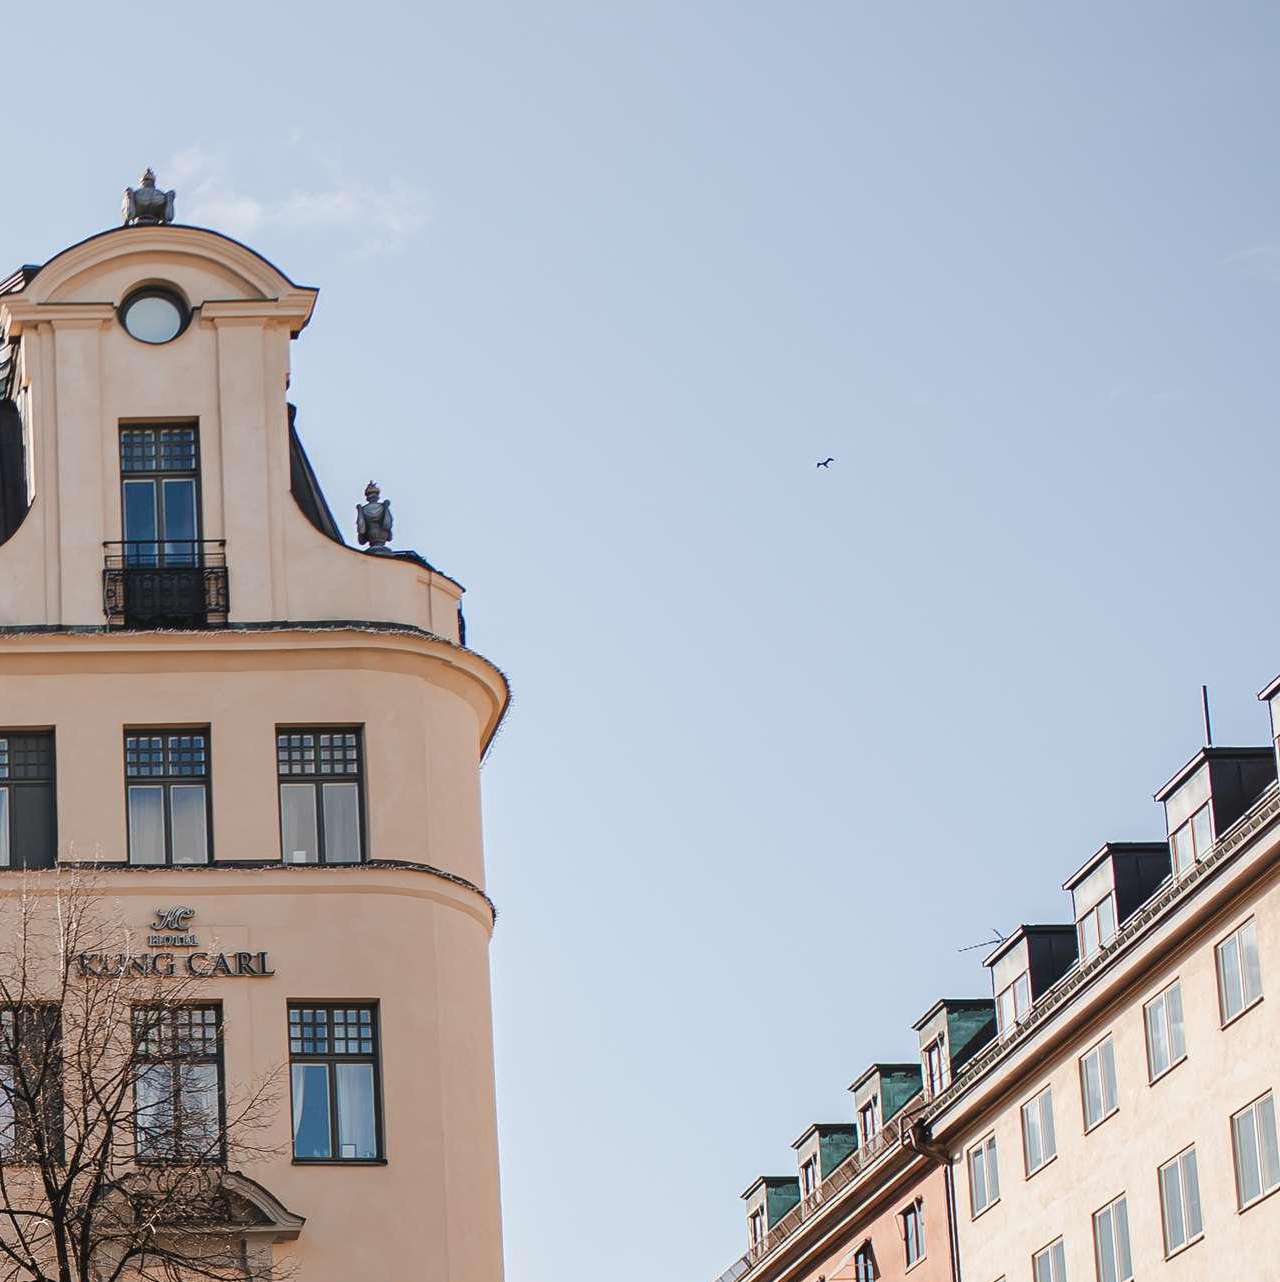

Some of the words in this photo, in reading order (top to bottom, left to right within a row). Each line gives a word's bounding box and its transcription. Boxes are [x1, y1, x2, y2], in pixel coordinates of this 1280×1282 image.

[148, 934, 199, 947] HOTEL
[78, 951, 176, 977] KUNG
[186, 951, 276, 977] CARL
